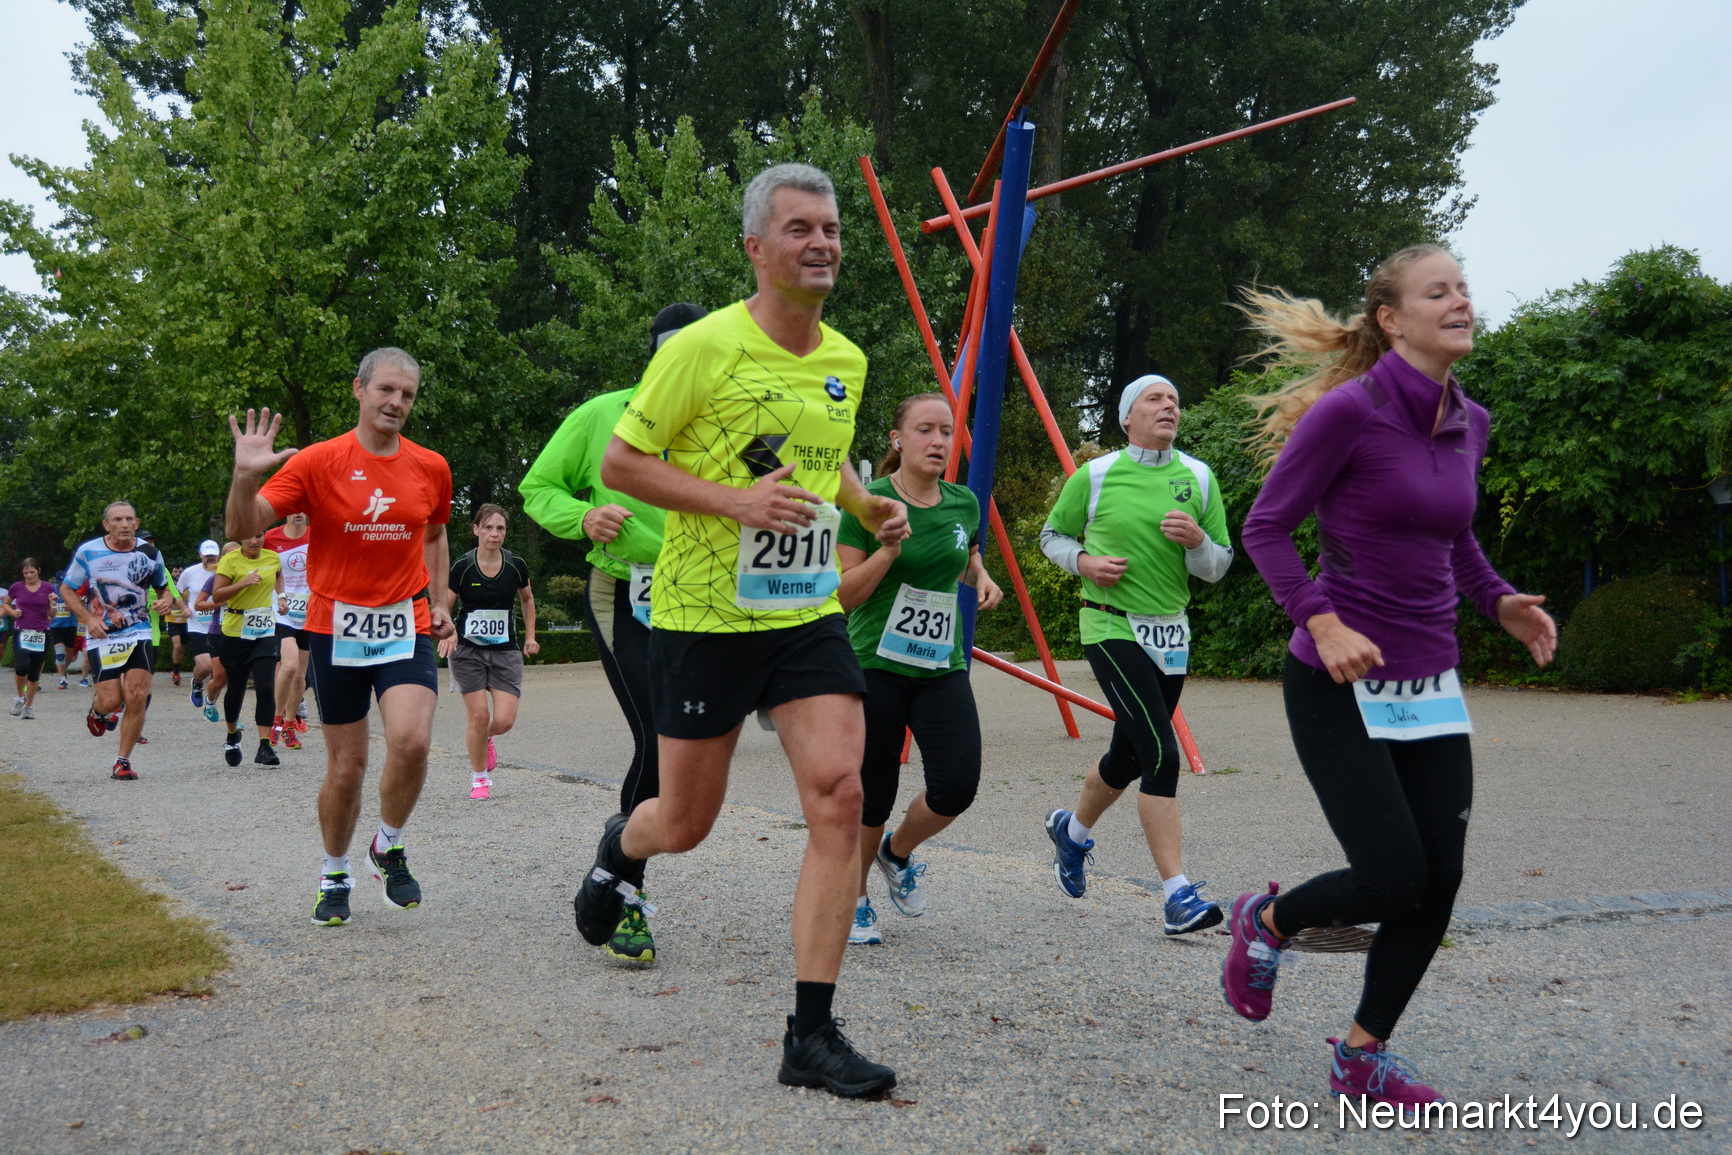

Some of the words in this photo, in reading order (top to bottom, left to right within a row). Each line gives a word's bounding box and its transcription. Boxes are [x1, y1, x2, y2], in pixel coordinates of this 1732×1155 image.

[634, 410, 656, 431] Partl
[793, 445, 813, 458] THE
[815, 447, 842, 459] NEXT
[802, 460, 821, 471] 100
[344, 522, 406, 533] funrunners
[362, 531, 412, 541] neumarkt
[752, 528, 831, 569] 2910
[767, 580, 816, 595] Werner
[247, 614, 273, 628] 2545
[342, 611, 408, 640] 2459
[470, 620, 505, 636] 2309
[894, 605, 951, 641] 2331
[23, 634, 43, 644] 2435
[1136, 624, 1185, 649] 2022
[363, 645, 386, 657] Uwe
[906, 642, 937, 658] Maria
[1385, 703, 1419, 724] Julia
